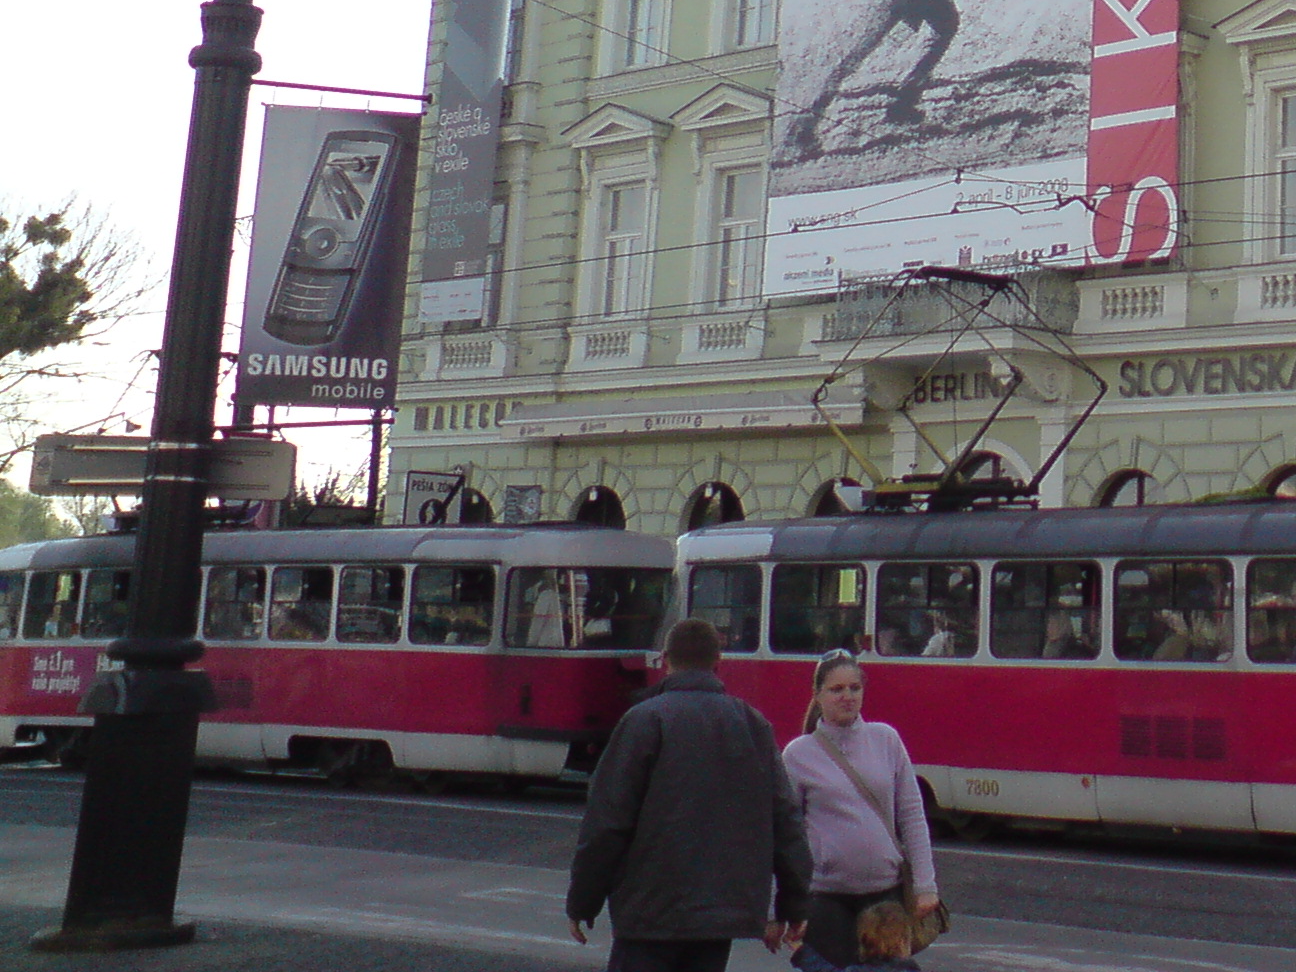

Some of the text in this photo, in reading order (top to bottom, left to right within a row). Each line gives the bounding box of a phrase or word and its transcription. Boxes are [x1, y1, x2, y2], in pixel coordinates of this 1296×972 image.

[437, 117, 491, 141] slovenské
[247, 353, 388, 379] SAMSUNG
[311, 382, 385, 399] mobile
